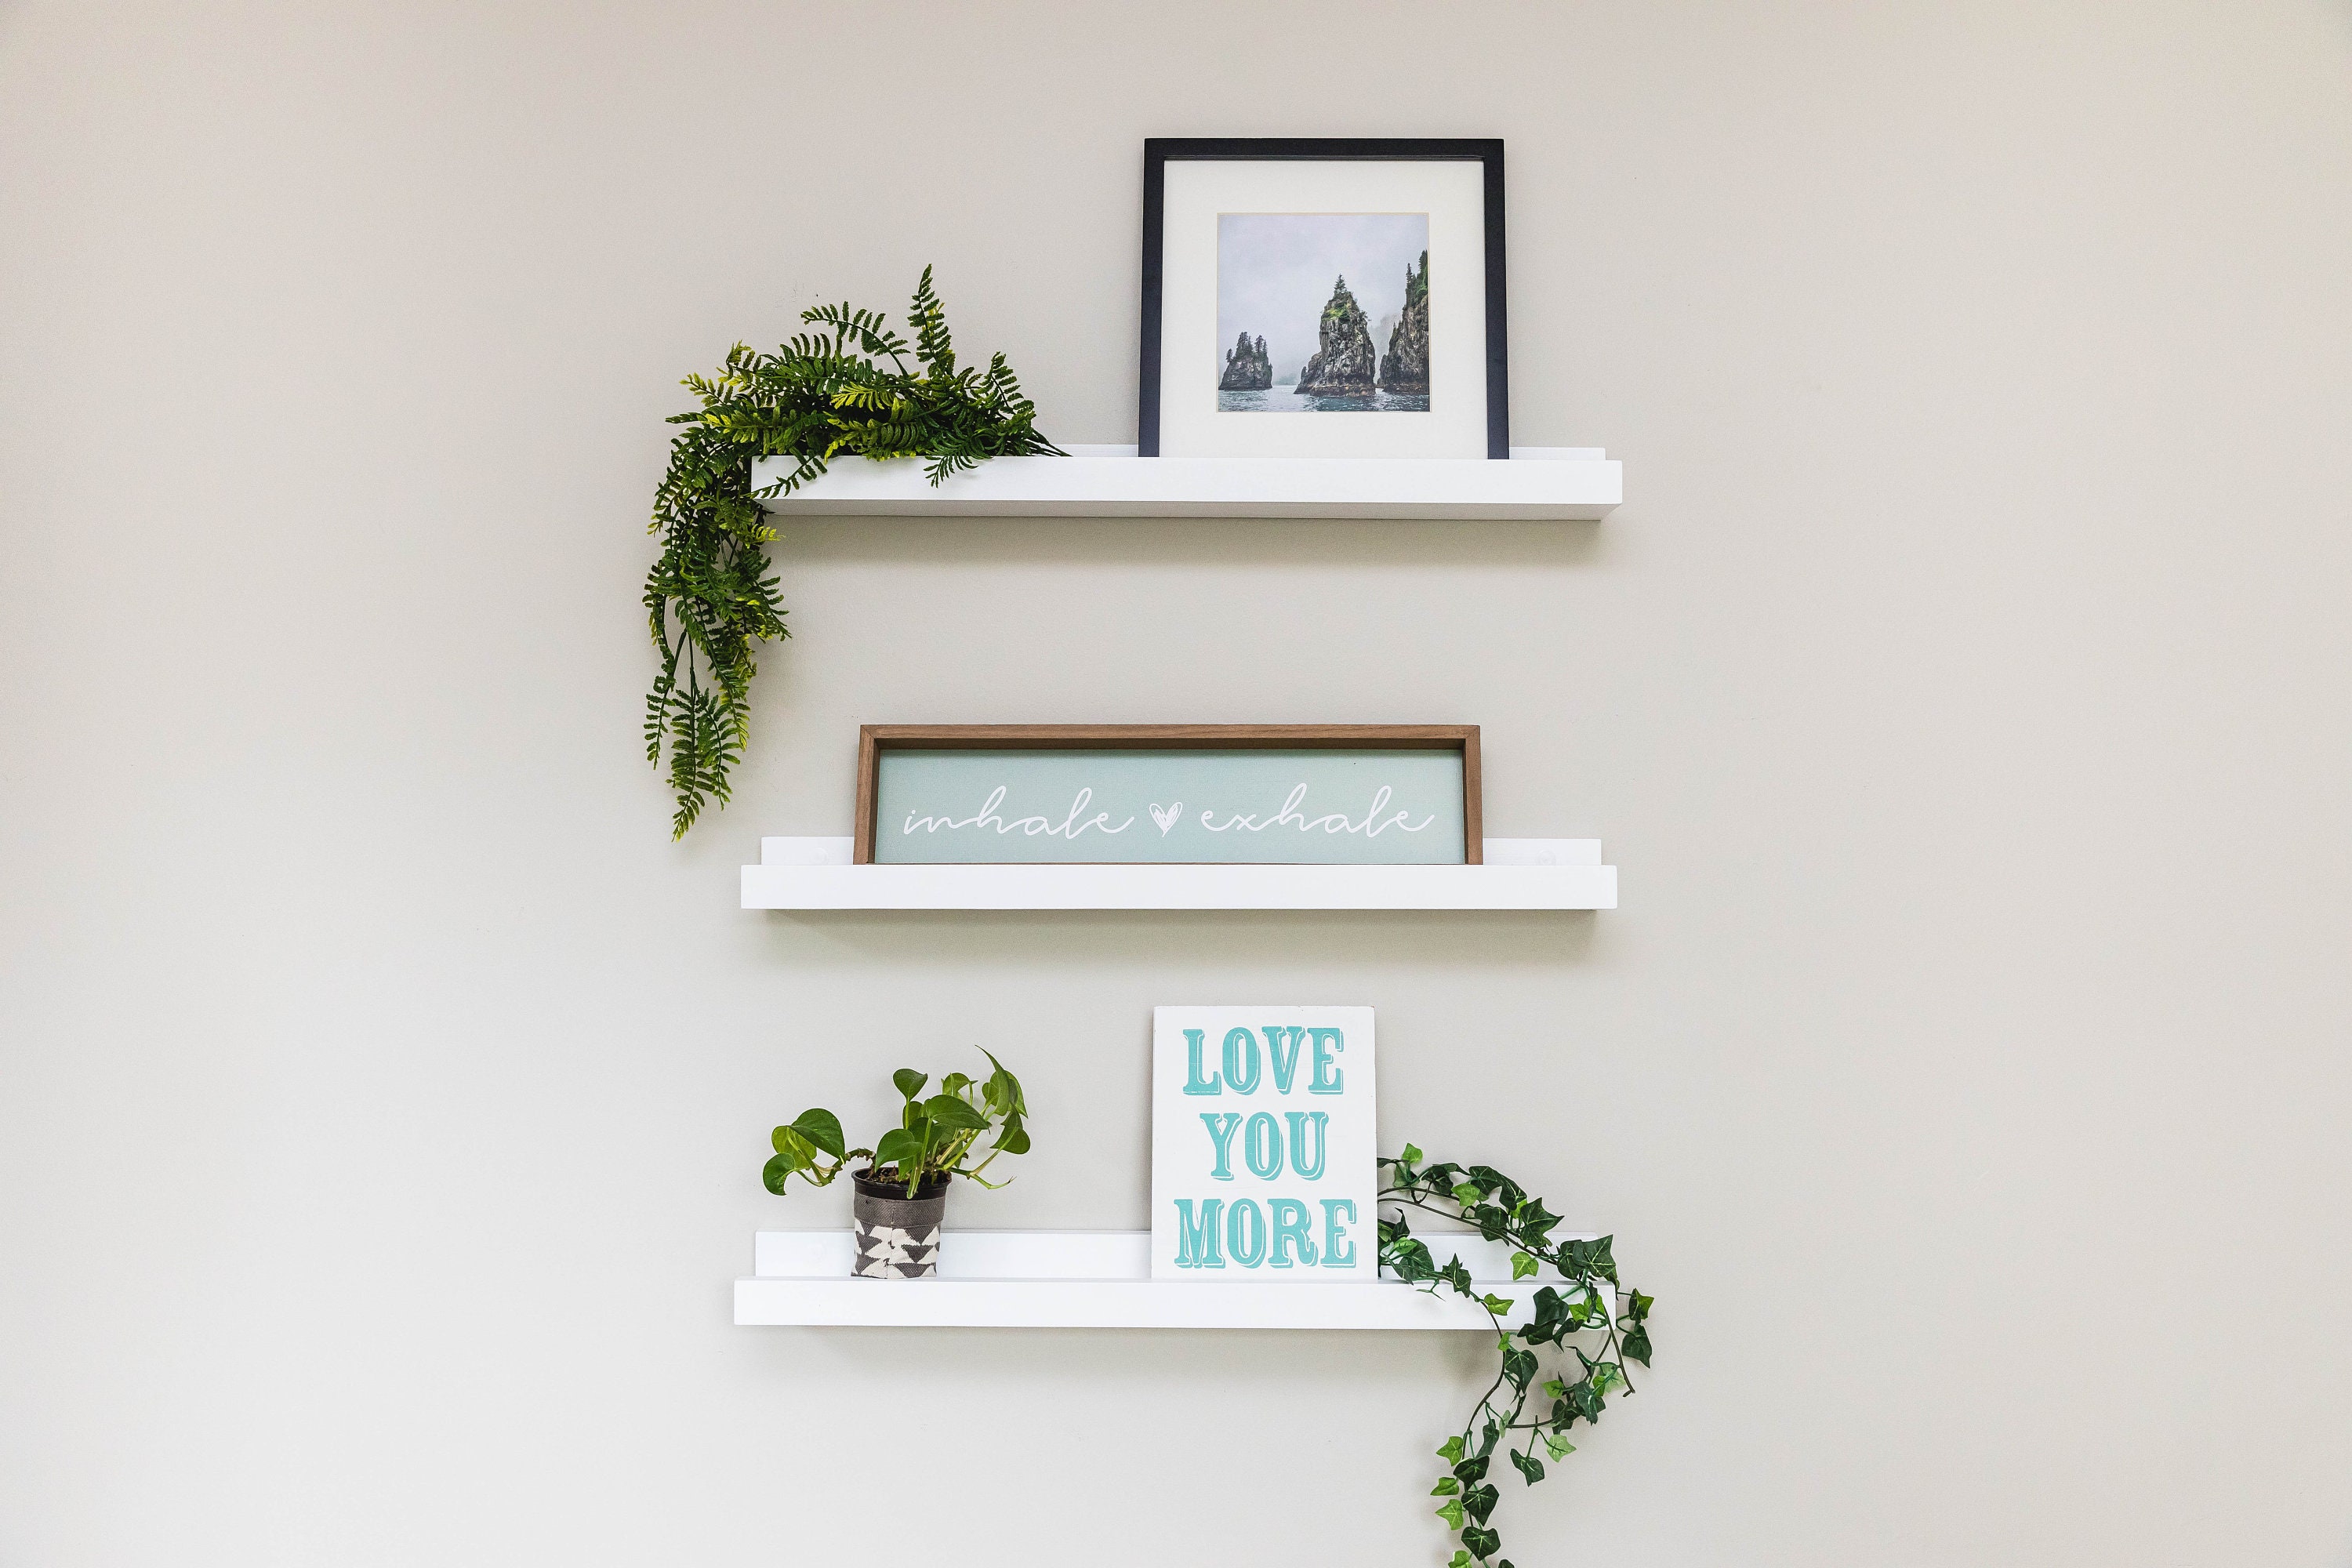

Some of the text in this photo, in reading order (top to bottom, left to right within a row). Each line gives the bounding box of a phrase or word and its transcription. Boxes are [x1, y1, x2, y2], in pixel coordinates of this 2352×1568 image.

[903, 782, 1436, 840] inhale exhale
[1182, 1025, 1345, 1096] LOVE
[1199, 1111, 1330, 1181] YOU
[1174, 1198, 1357, 1269] MORE
